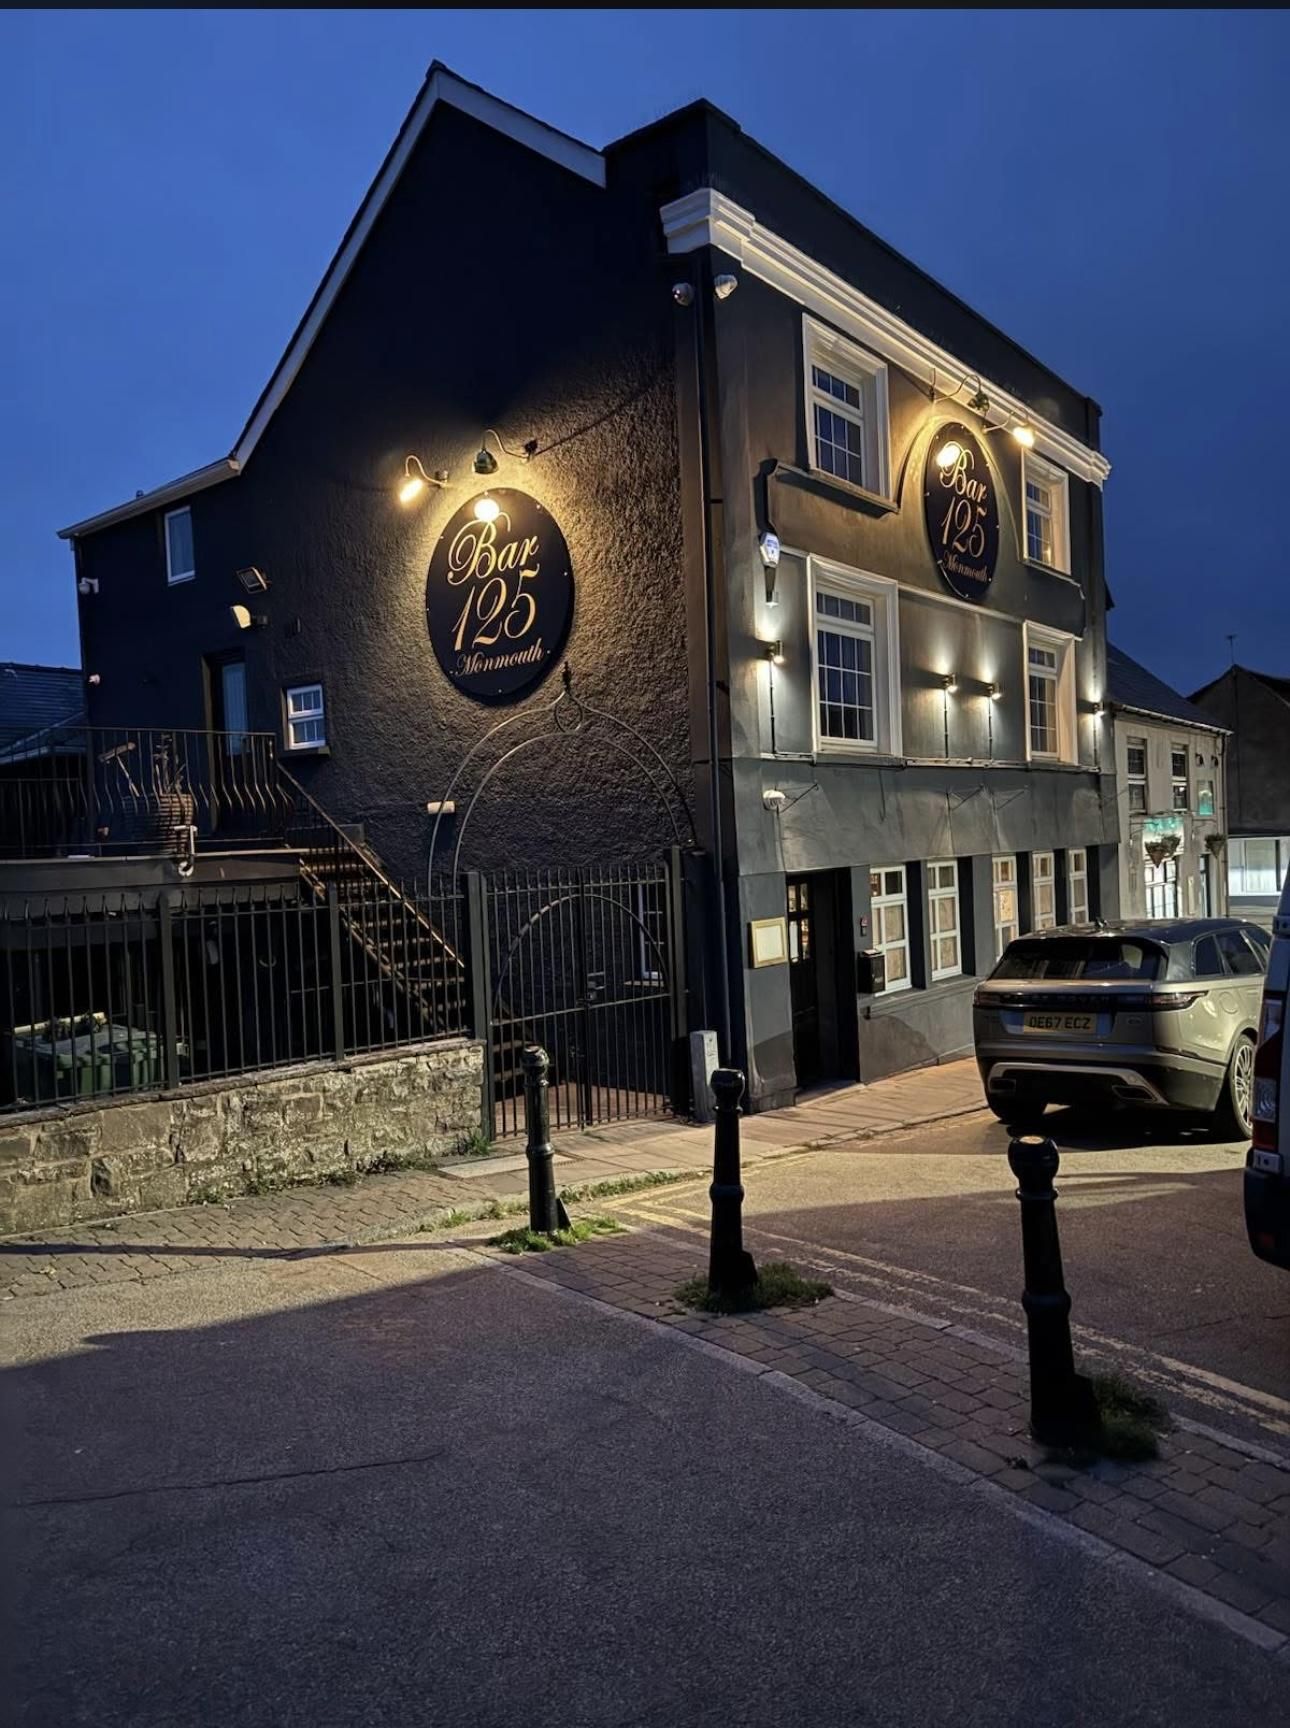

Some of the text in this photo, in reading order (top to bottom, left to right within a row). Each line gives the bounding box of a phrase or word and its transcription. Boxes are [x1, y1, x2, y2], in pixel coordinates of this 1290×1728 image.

[940, 441, 987, 502] Bar
[447, 510, 540, 585] Bar
[941, 497, 987, 558] 125
[452, 563, 540, 651] 125
[455, 638, 542, 676] Monmouth
[1065, 1016, 1091, 1030] ECZ
